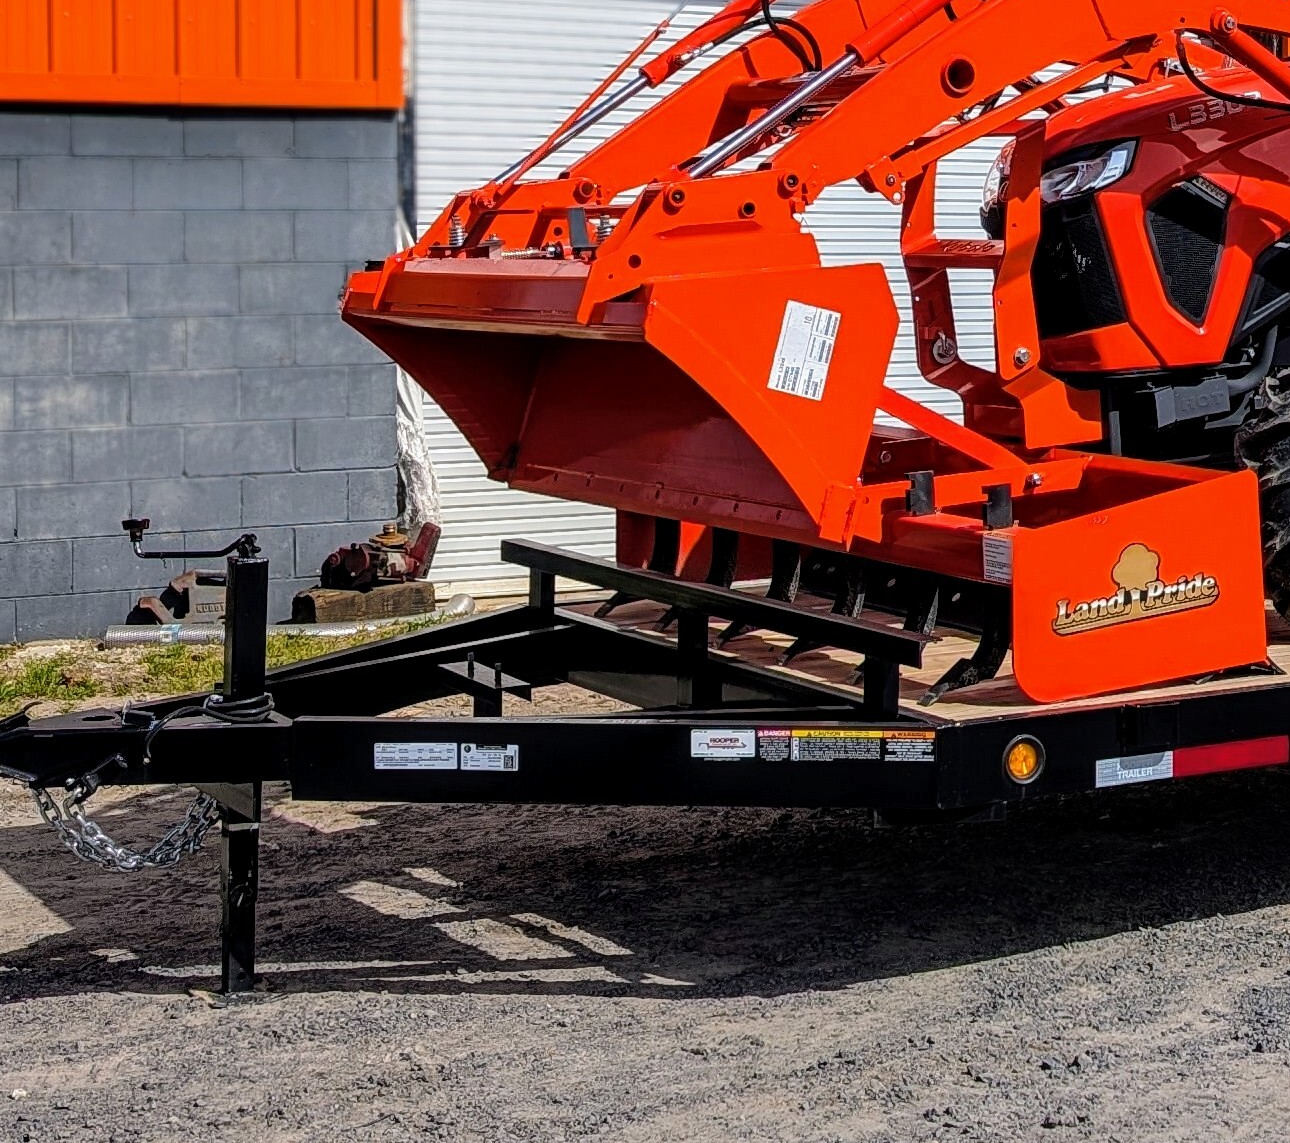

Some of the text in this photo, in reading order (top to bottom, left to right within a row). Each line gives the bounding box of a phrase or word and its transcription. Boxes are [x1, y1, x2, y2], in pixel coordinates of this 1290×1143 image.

[1055, 572, 1217, 626] Land Pride
[1116, 767, 1153, 780] TRAILER
